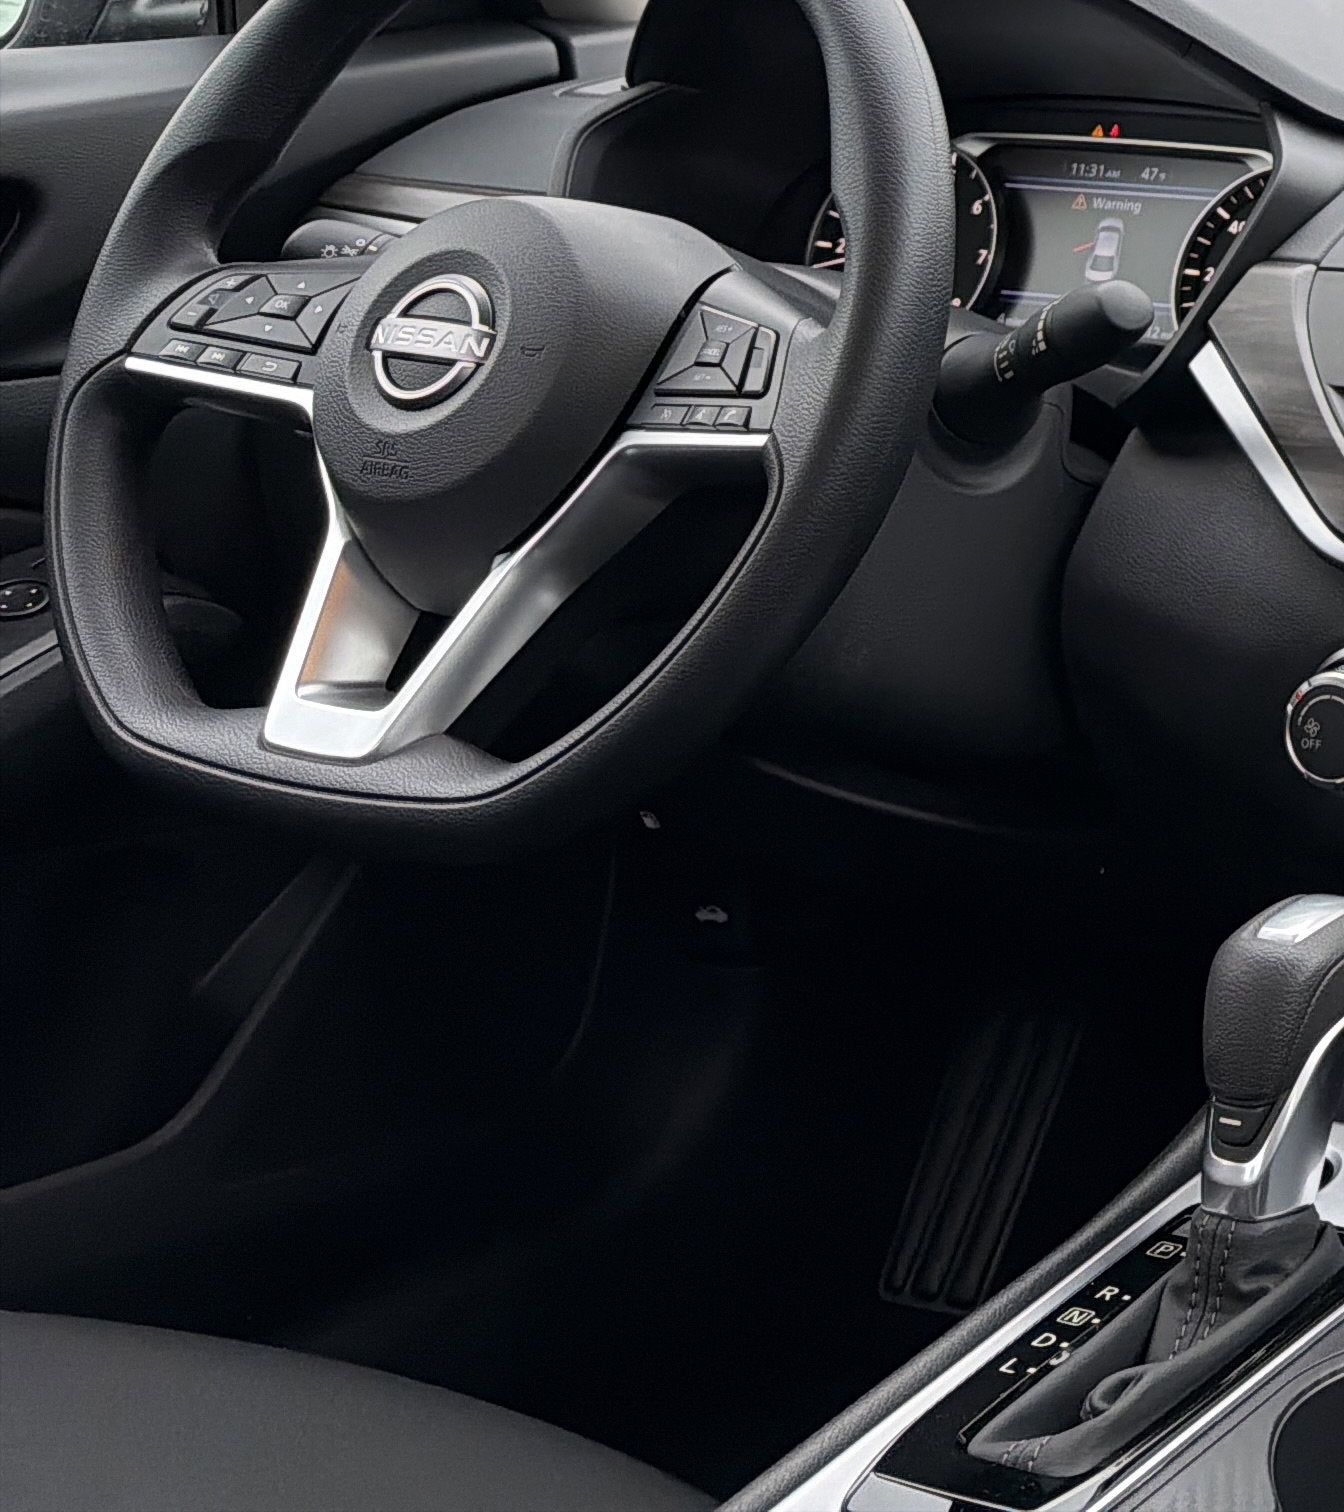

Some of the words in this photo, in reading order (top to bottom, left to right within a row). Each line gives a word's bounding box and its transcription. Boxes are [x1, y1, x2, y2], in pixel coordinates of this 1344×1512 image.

[1070, 162, 1105, 178] 11:31
[971, 199, 983, 216] 6
[1092, 196, 1142, 213] Warning
[975, 248, 988, 265] 7
[274, 299, 291, 310] OK
[371, 322, 490, 357] NISSAN
[1300, 739, 1322, 751] OFF
[1094, 1285, 1120, 1301] R
[1065, 1311, 1086, 1323] N
[1031, 1332, 1057, 1347] D
[998, 1357, 1019, 1373] L
